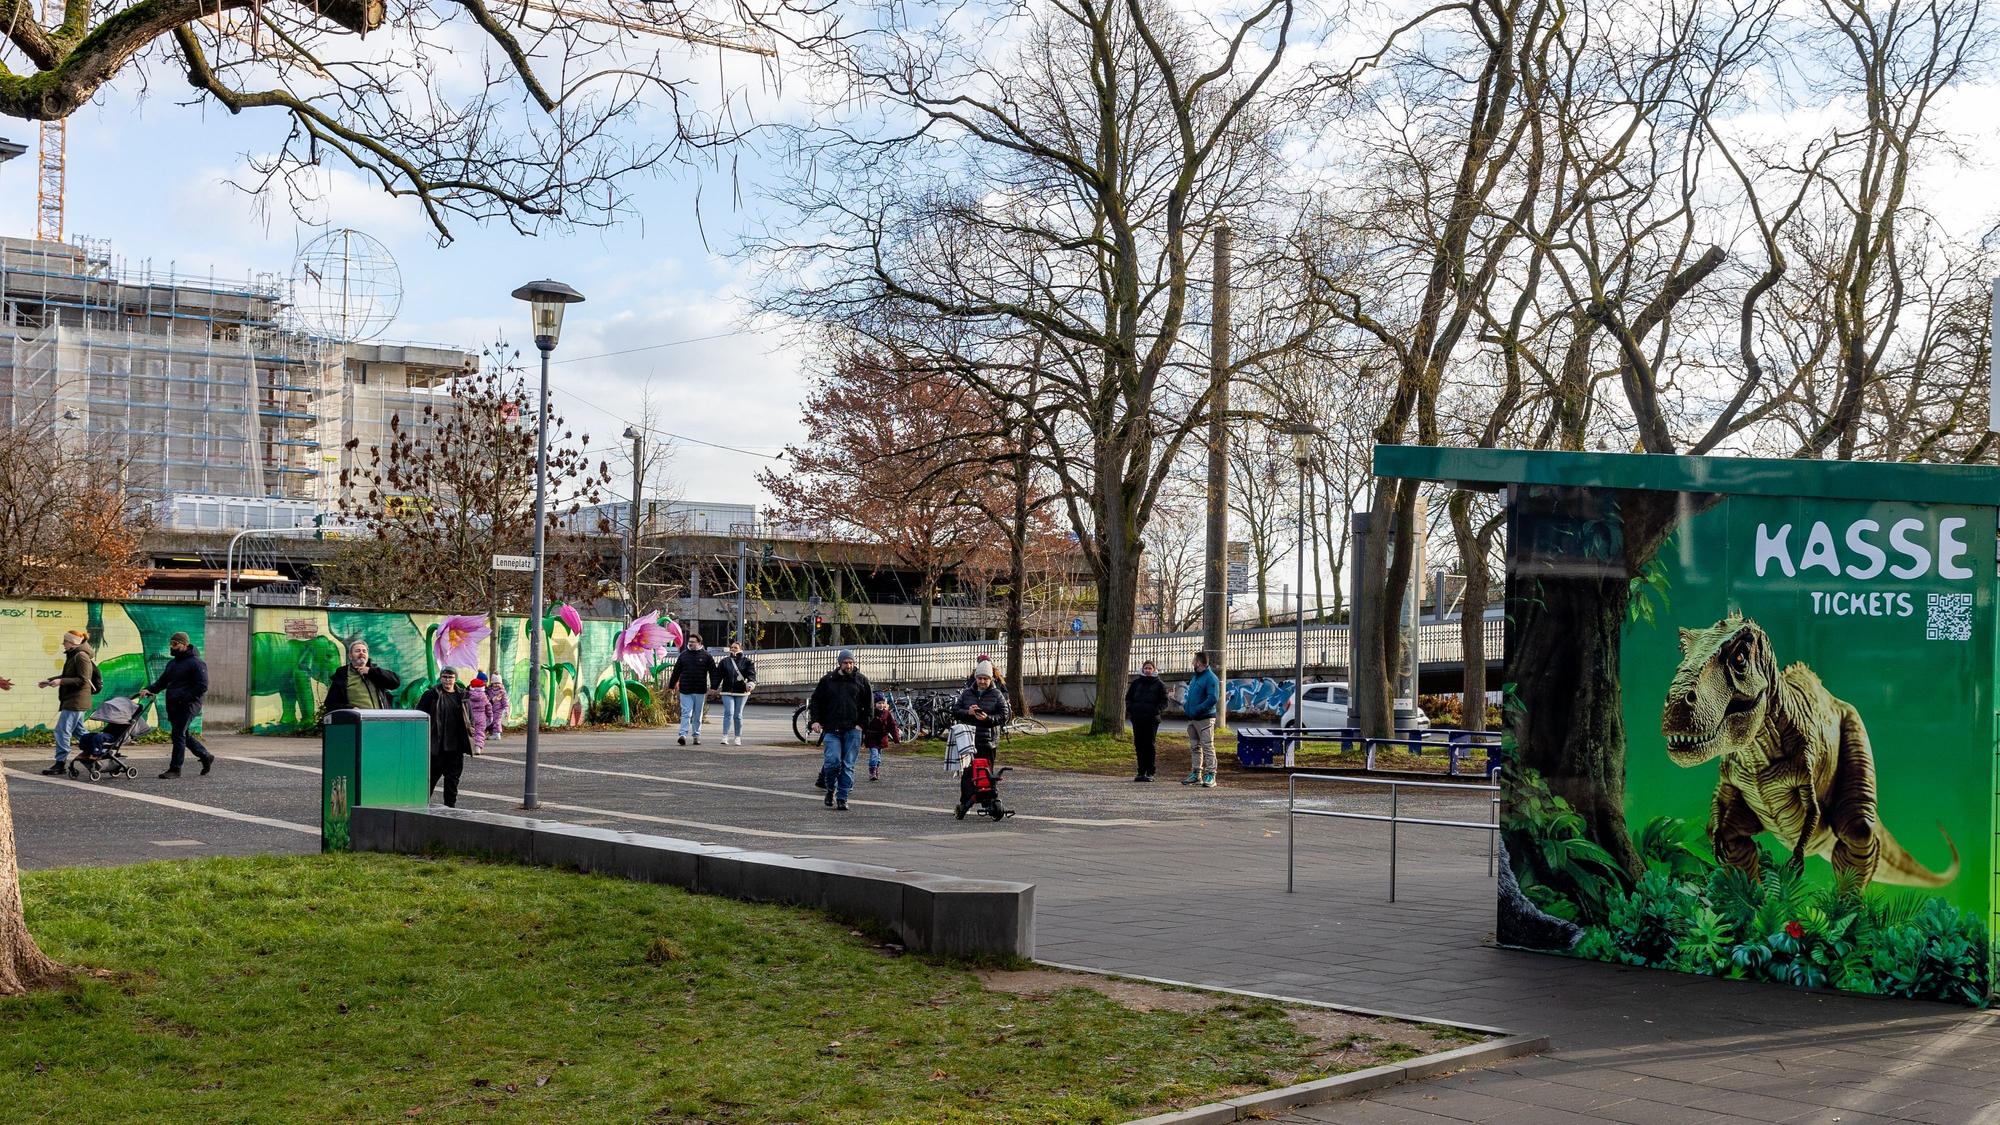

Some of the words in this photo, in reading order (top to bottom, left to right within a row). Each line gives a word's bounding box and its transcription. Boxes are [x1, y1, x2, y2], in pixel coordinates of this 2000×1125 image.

[1755, 517, 1974, 580] KASSE
[496, 556, 531, 569] Lennéplatz
[1810, 591, 1914, 617] TICKETS
